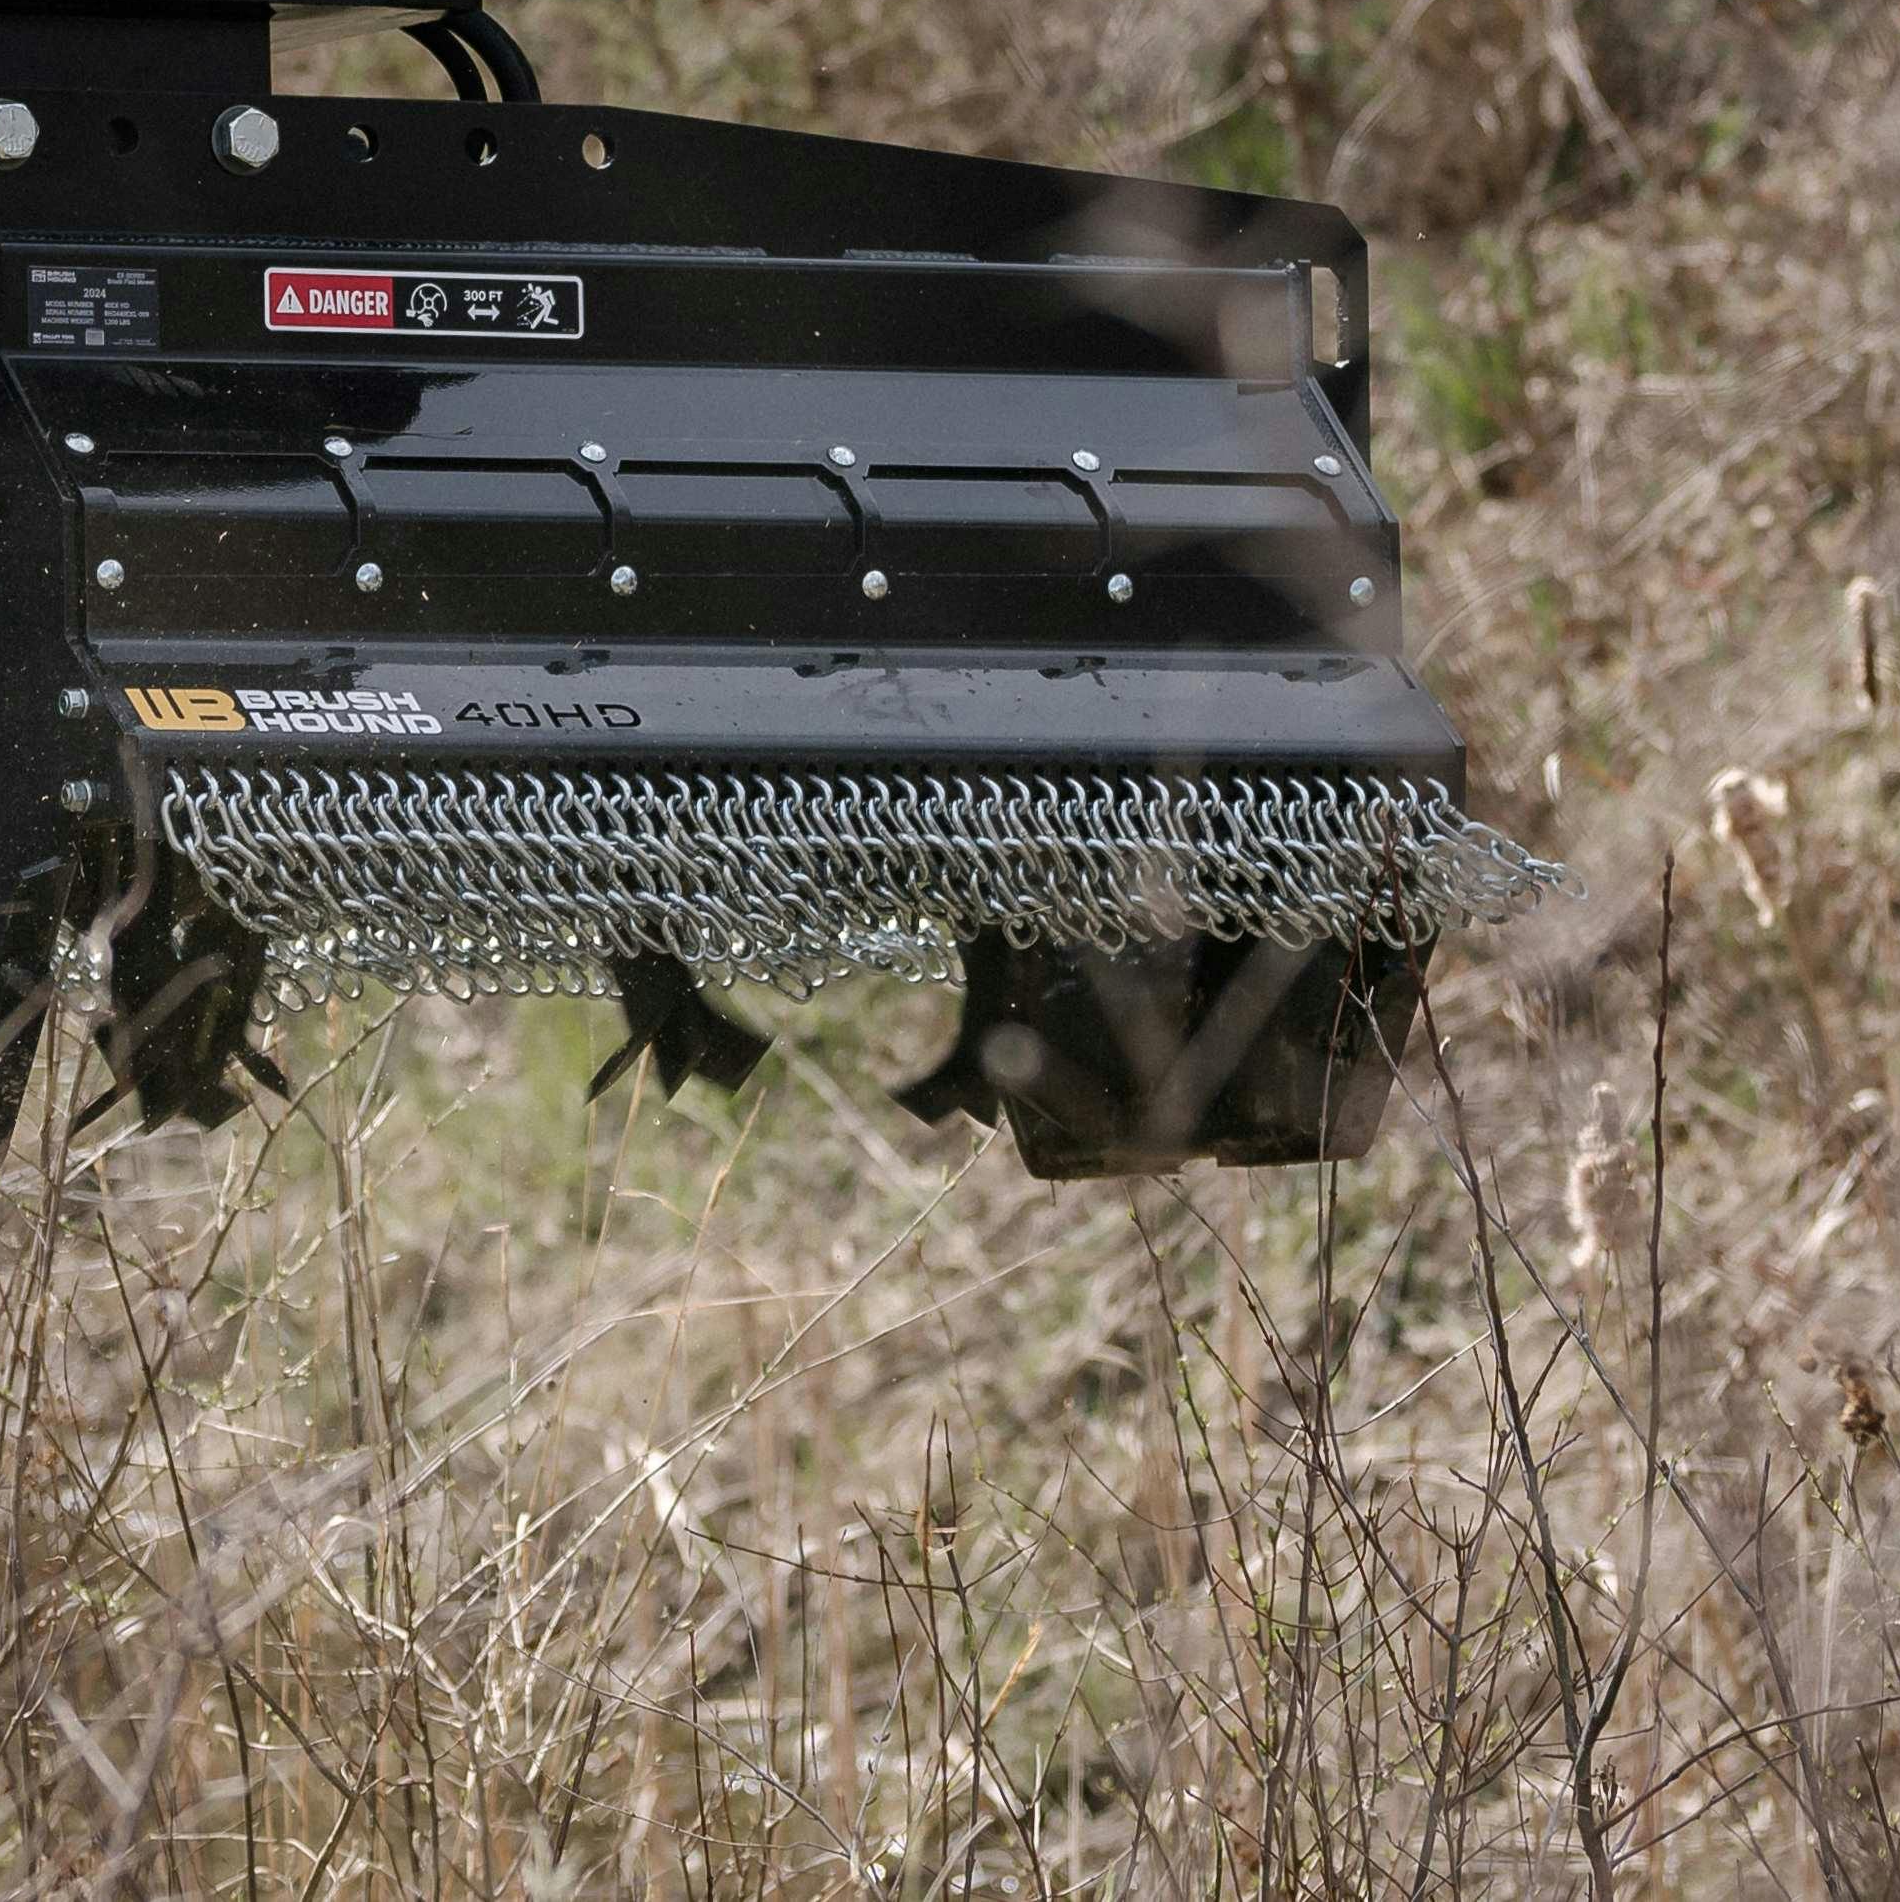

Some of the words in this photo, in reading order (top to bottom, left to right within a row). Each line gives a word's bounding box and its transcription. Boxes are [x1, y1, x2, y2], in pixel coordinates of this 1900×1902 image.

[83, 288, 106, 298] 2024
[308, 288, 389, 316] DANGER
[463, 289, 486, 302] 300
[488, 290, 503, 303] FT
[234, 689, 422, 711] BRUSH
[455, 702, 642, 728] 40HD
[249, 711, 444, 735] HOUND
